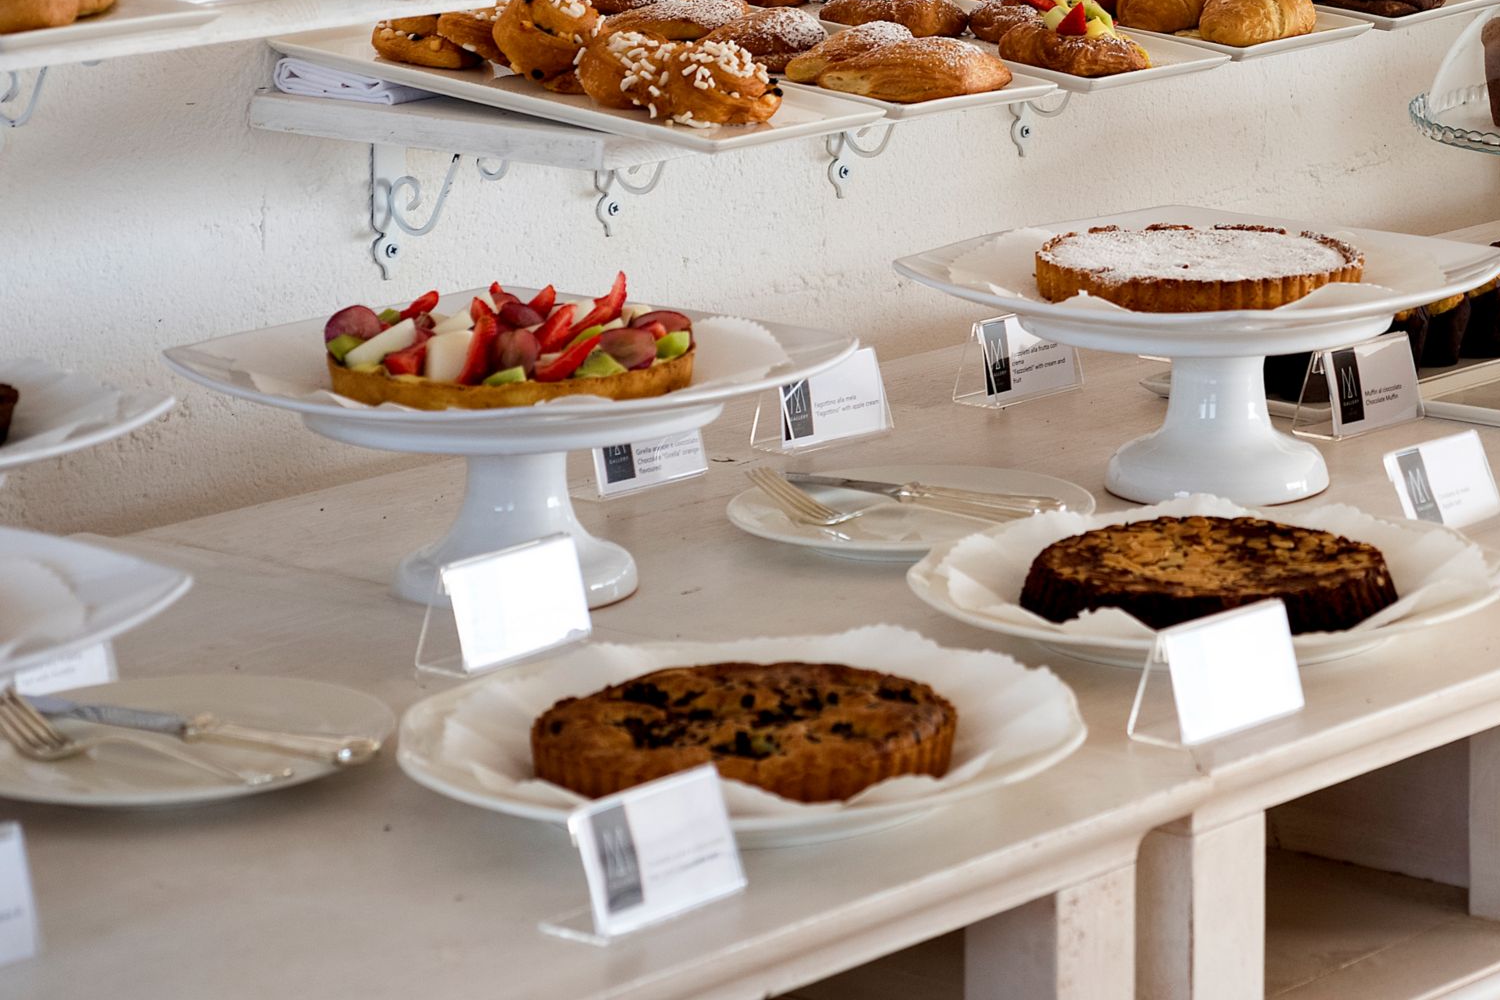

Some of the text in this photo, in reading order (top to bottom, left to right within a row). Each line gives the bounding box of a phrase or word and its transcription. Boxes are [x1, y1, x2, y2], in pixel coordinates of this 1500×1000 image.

[1038, 344, 1050, 352] frutta
[1011, 359, 1025, 367] crema
[1035, 362, 1044, 370] with
[1044, 360, 1057, 368] cream
[1057, 356, 1066, 365] and
[1364, 389, 1378, 397] Muffin
[1382, 384, 1402, 393] cioccolato
[842, 404, 851, 412] with
[852, 402, 865, 410] apple
[865, 399, 881, 407] cream
[1365, 393, 1399, 406] Chocolate Muffin
[635, 447, 652, 456] Girella
